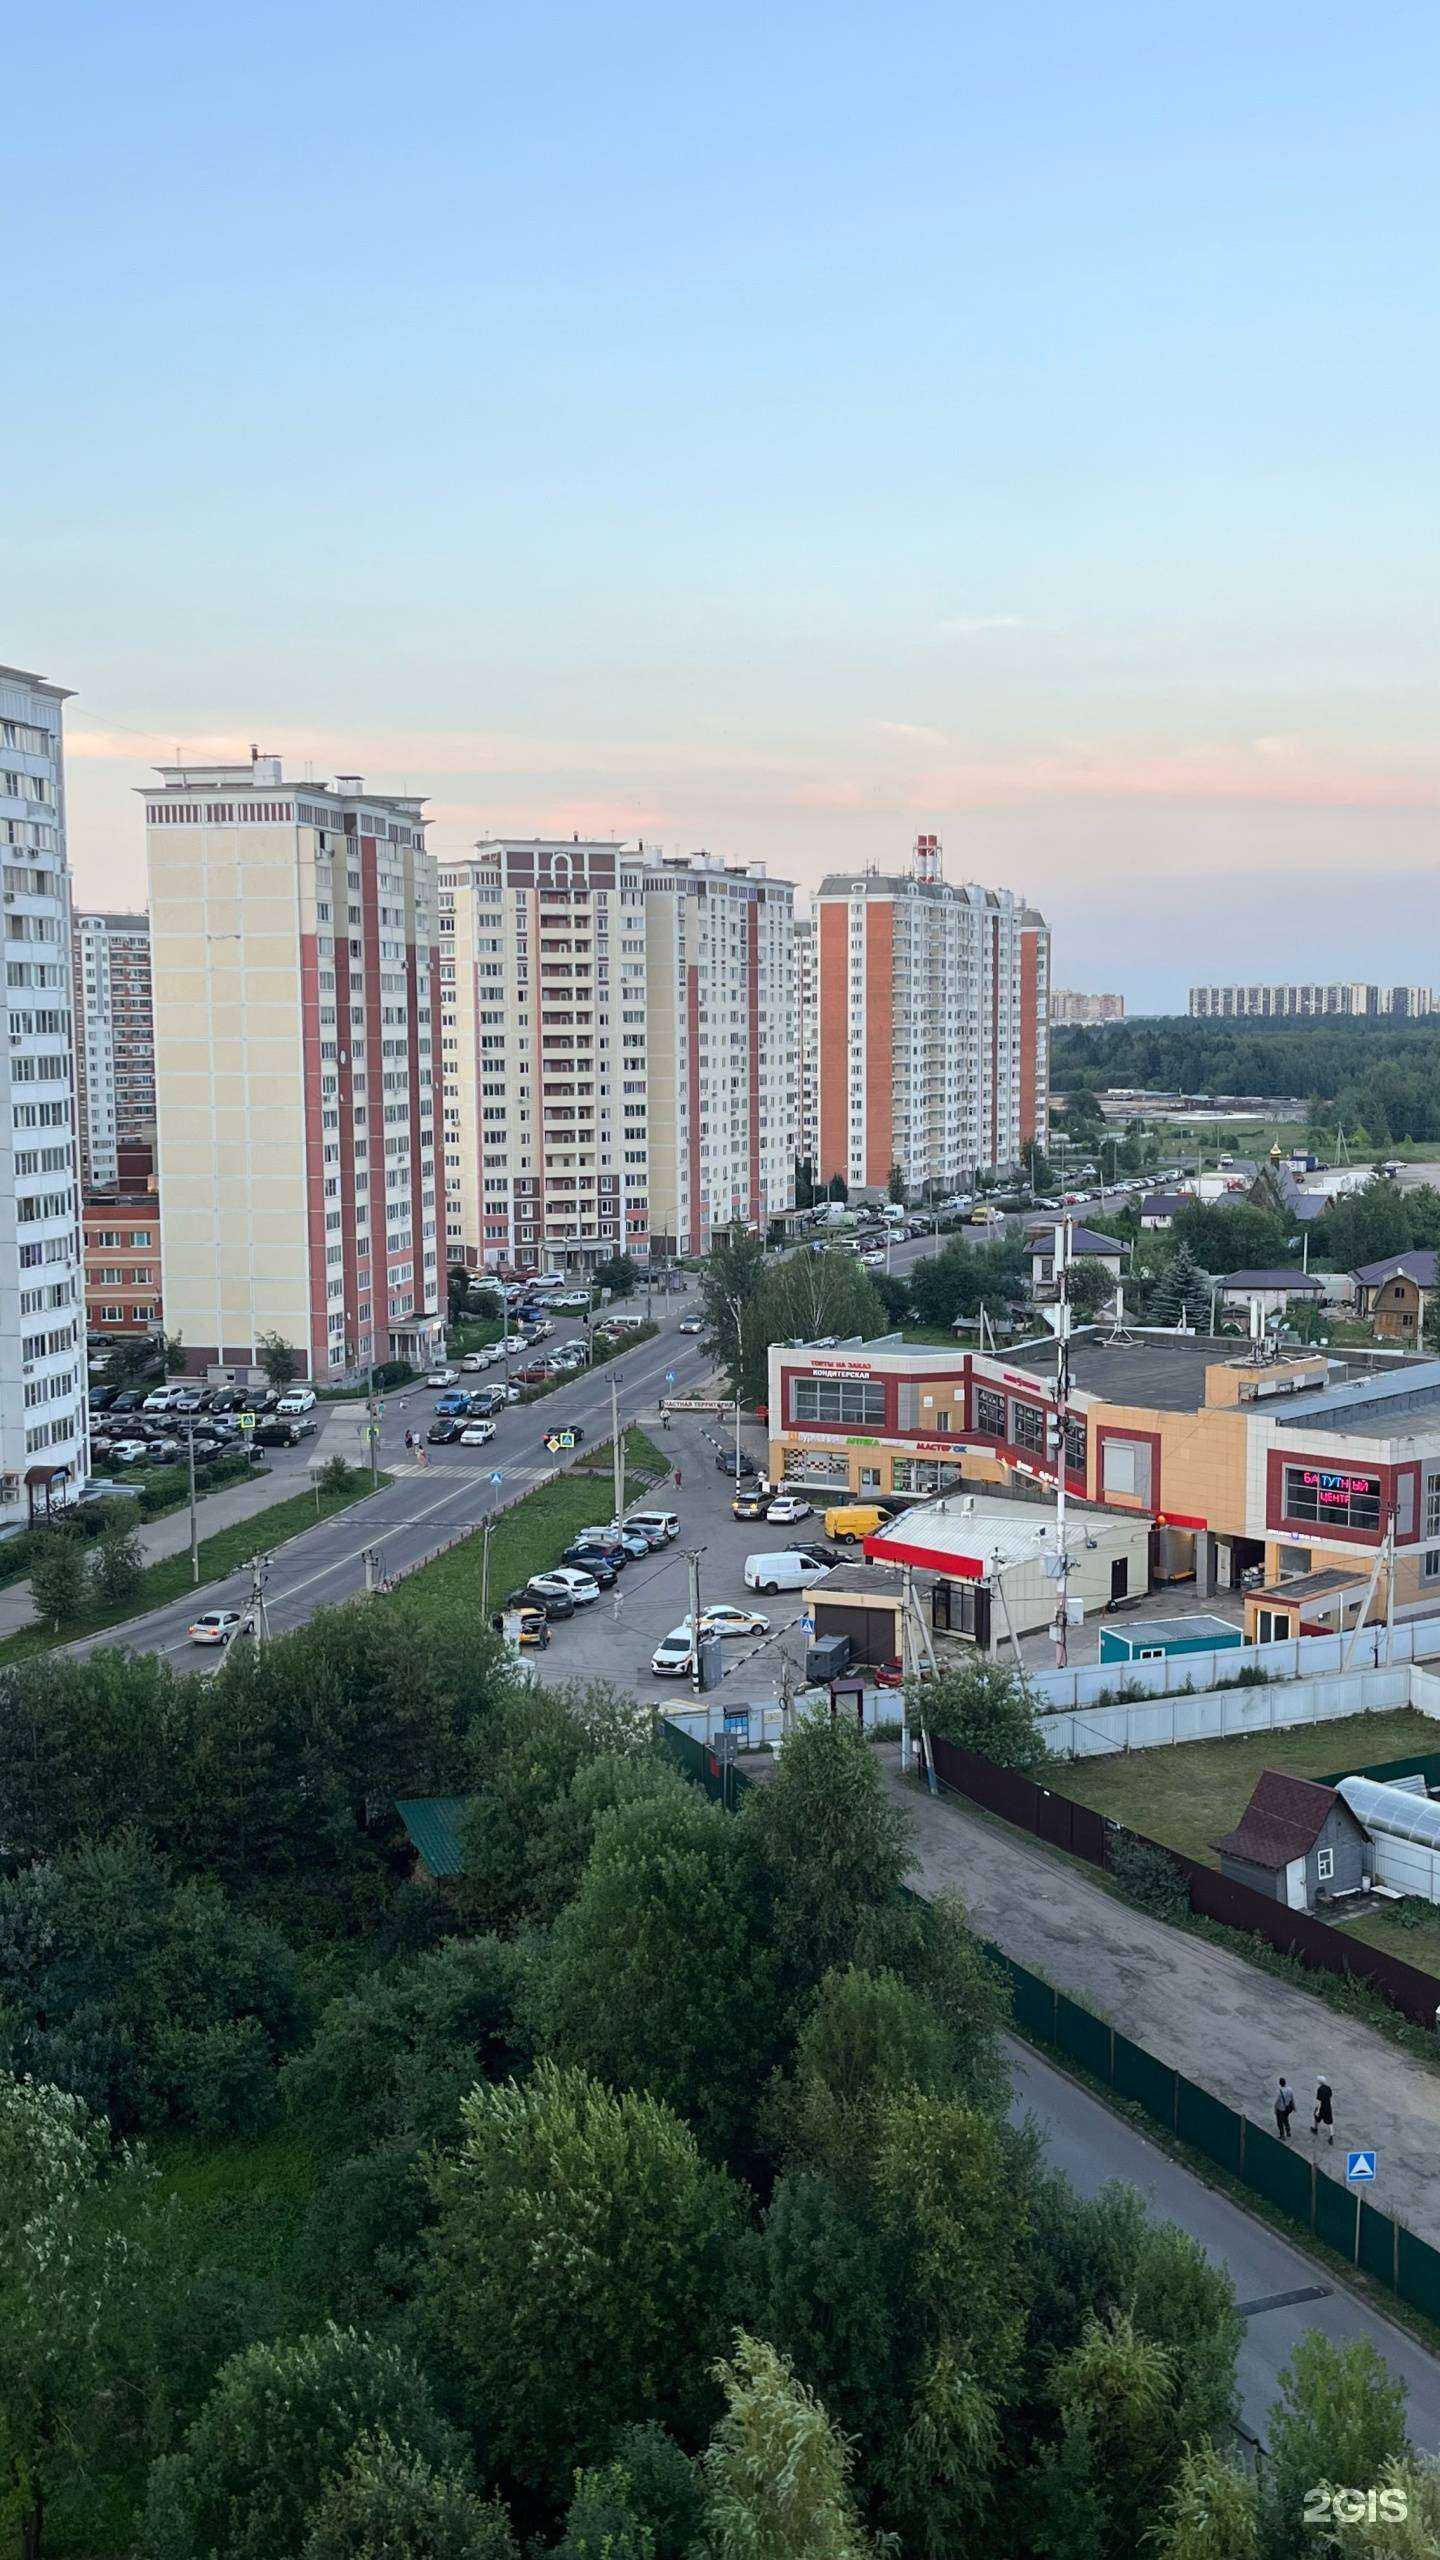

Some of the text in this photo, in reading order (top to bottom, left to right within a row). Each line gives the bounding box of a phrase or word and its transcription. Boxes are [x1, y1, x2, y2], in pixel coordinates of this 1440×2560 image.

[811, 1360, 834, 1368] ТОРТЫ
[848, 1362, 872, 1370] ЗАКАЗ
[812, 1369, 870, 1379] КОНДИТЕРСКАЯ
[846, 1436, 880, 1447] АПТЕКА
[1320, 1491, 1351, 1504] ЦЕНТР
